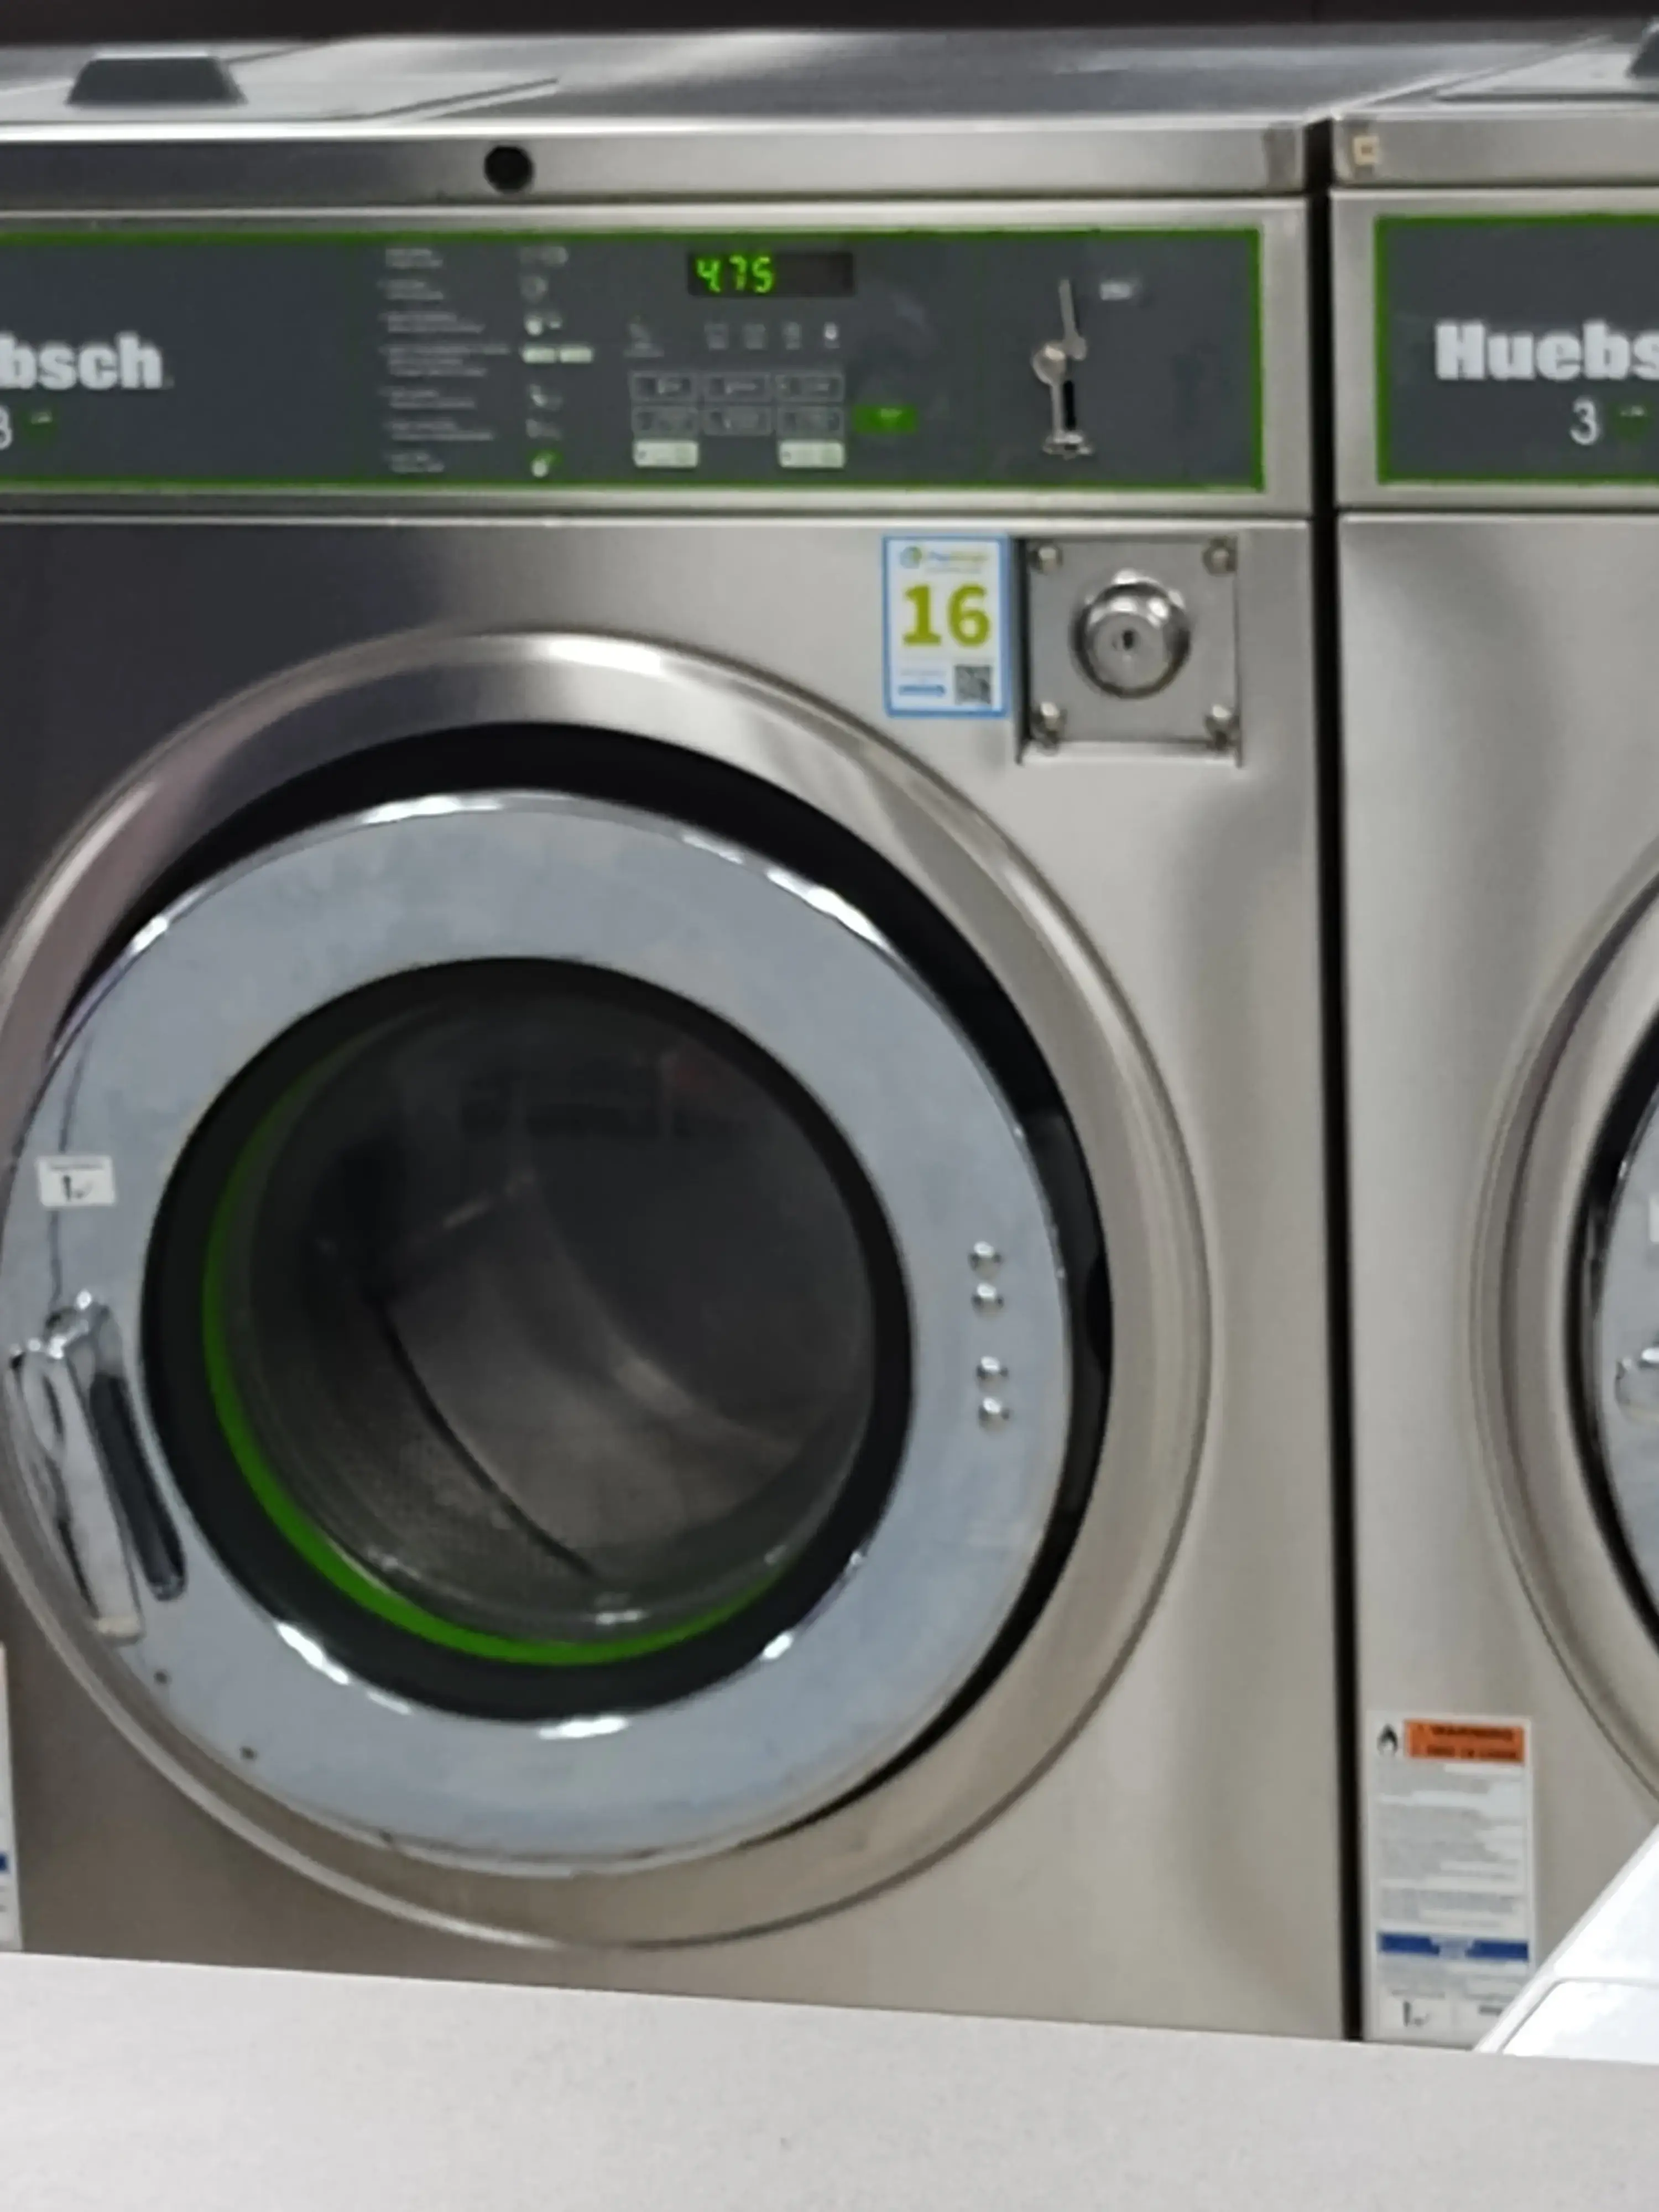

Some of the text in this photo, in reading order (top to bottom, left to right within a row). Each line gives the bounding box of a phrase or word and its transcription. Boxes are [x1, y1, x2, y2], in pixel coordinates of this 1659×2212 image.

[1435, 319, 1659, 382] Huebs
[1569, 398, 1600, 446] 3
[902, 583, 992, 648] 16
